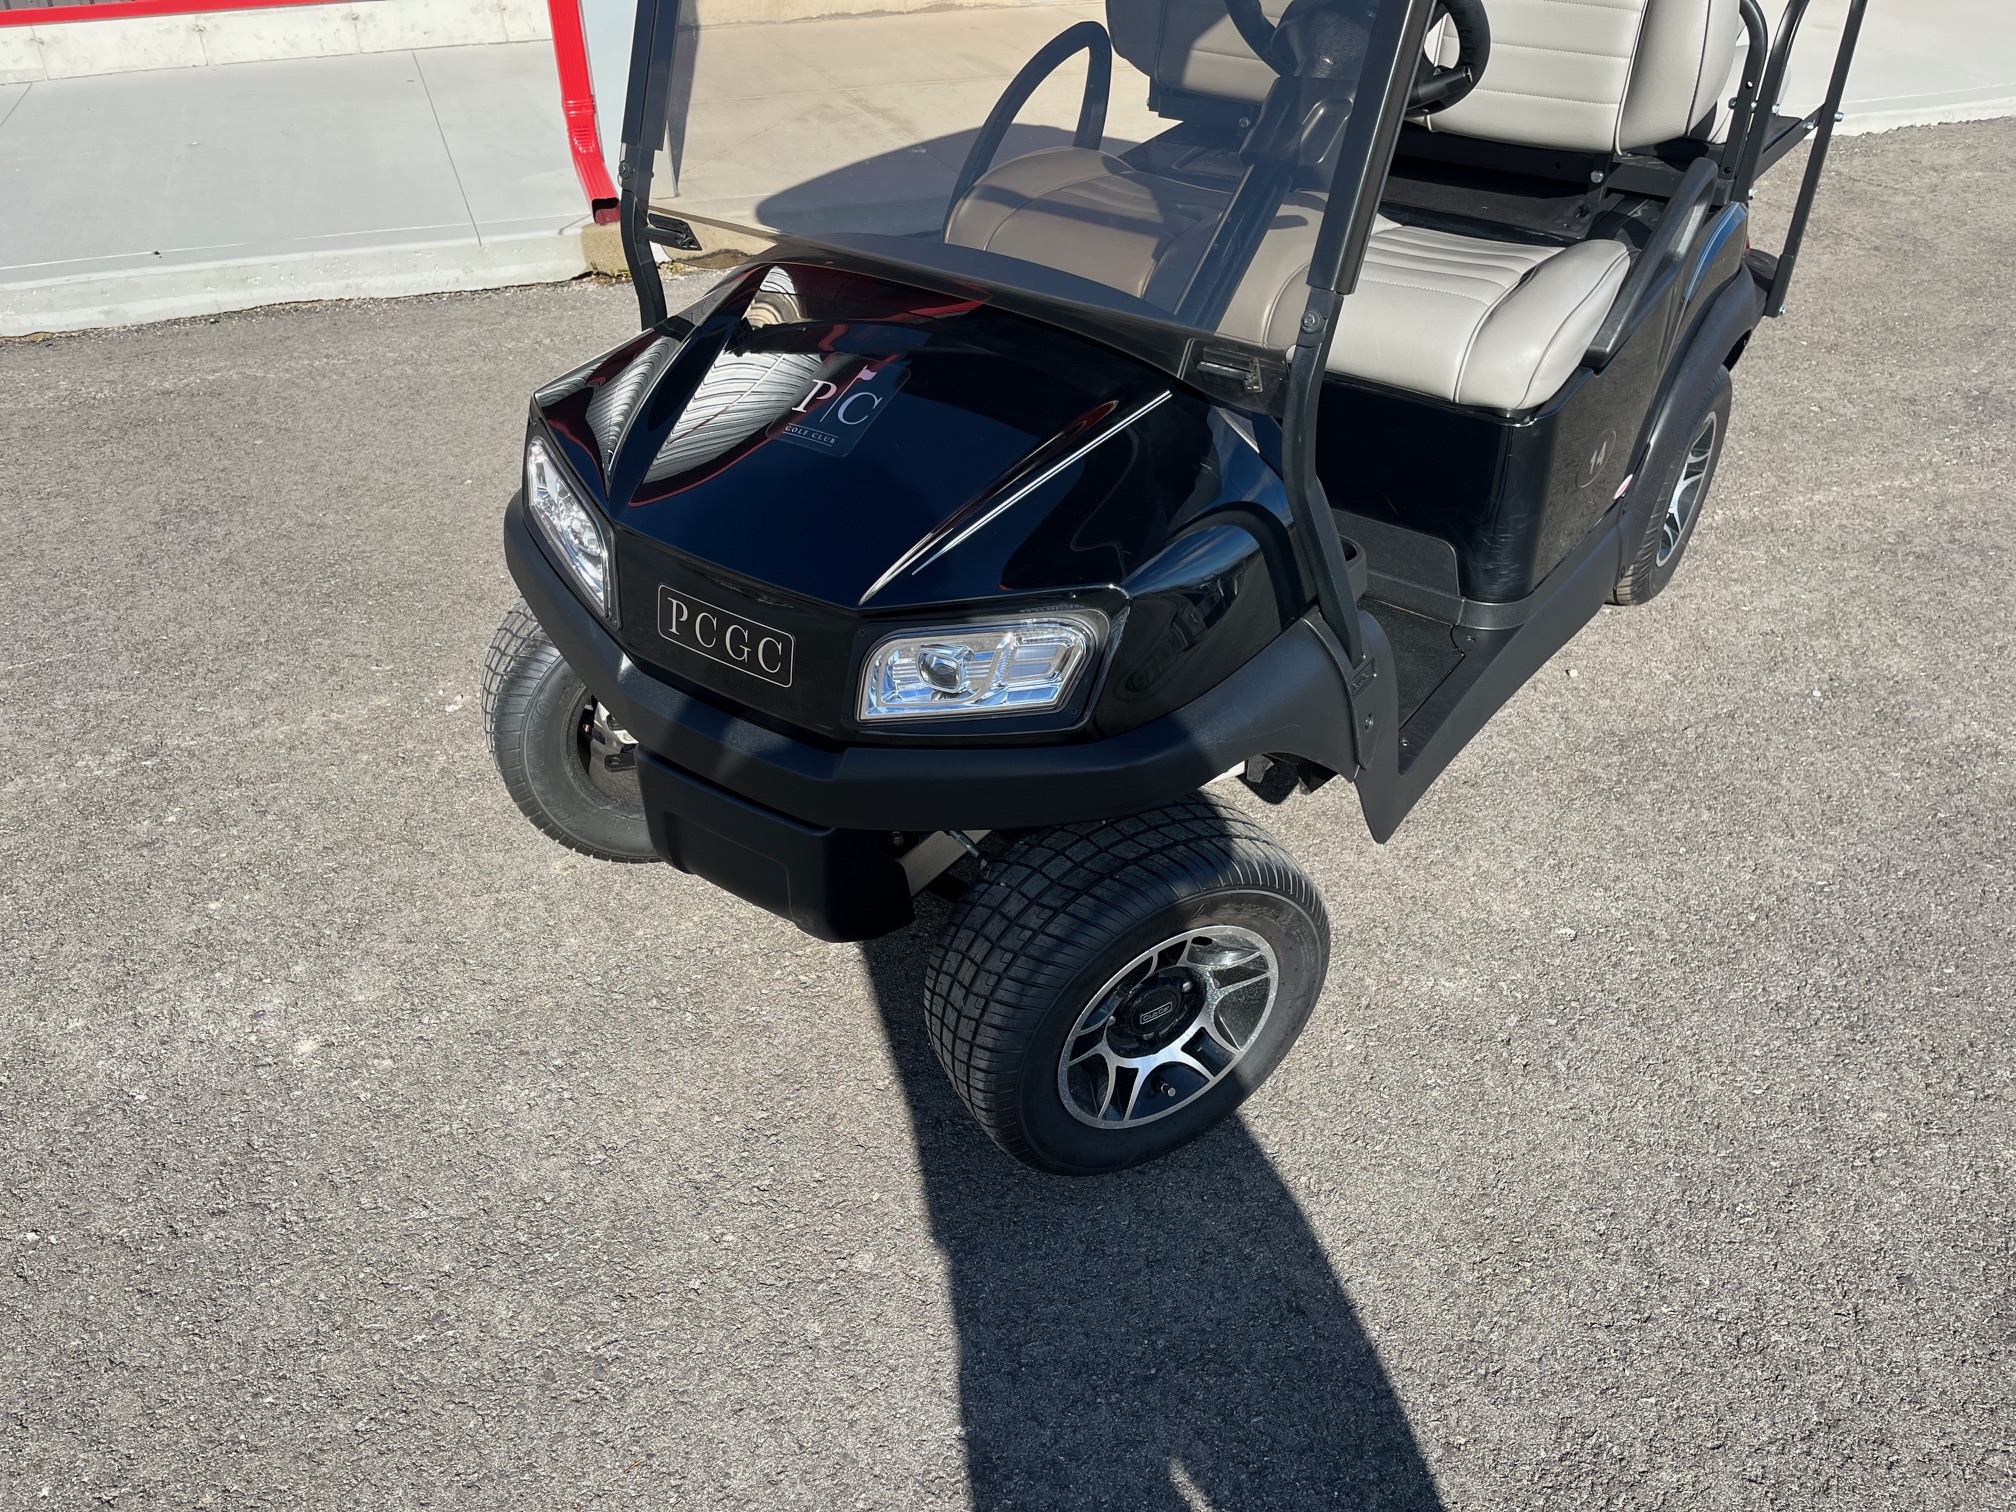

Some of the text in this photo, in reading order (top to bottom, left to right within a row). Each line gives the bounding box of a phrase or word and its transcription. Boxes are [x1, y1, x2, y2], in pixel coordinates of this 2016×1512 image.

[785, 425, 836, 445] GOLF CLUB
[667, 596, 783, 674] PCGC
[1142, 1005, 1170, 1021] Club Car
